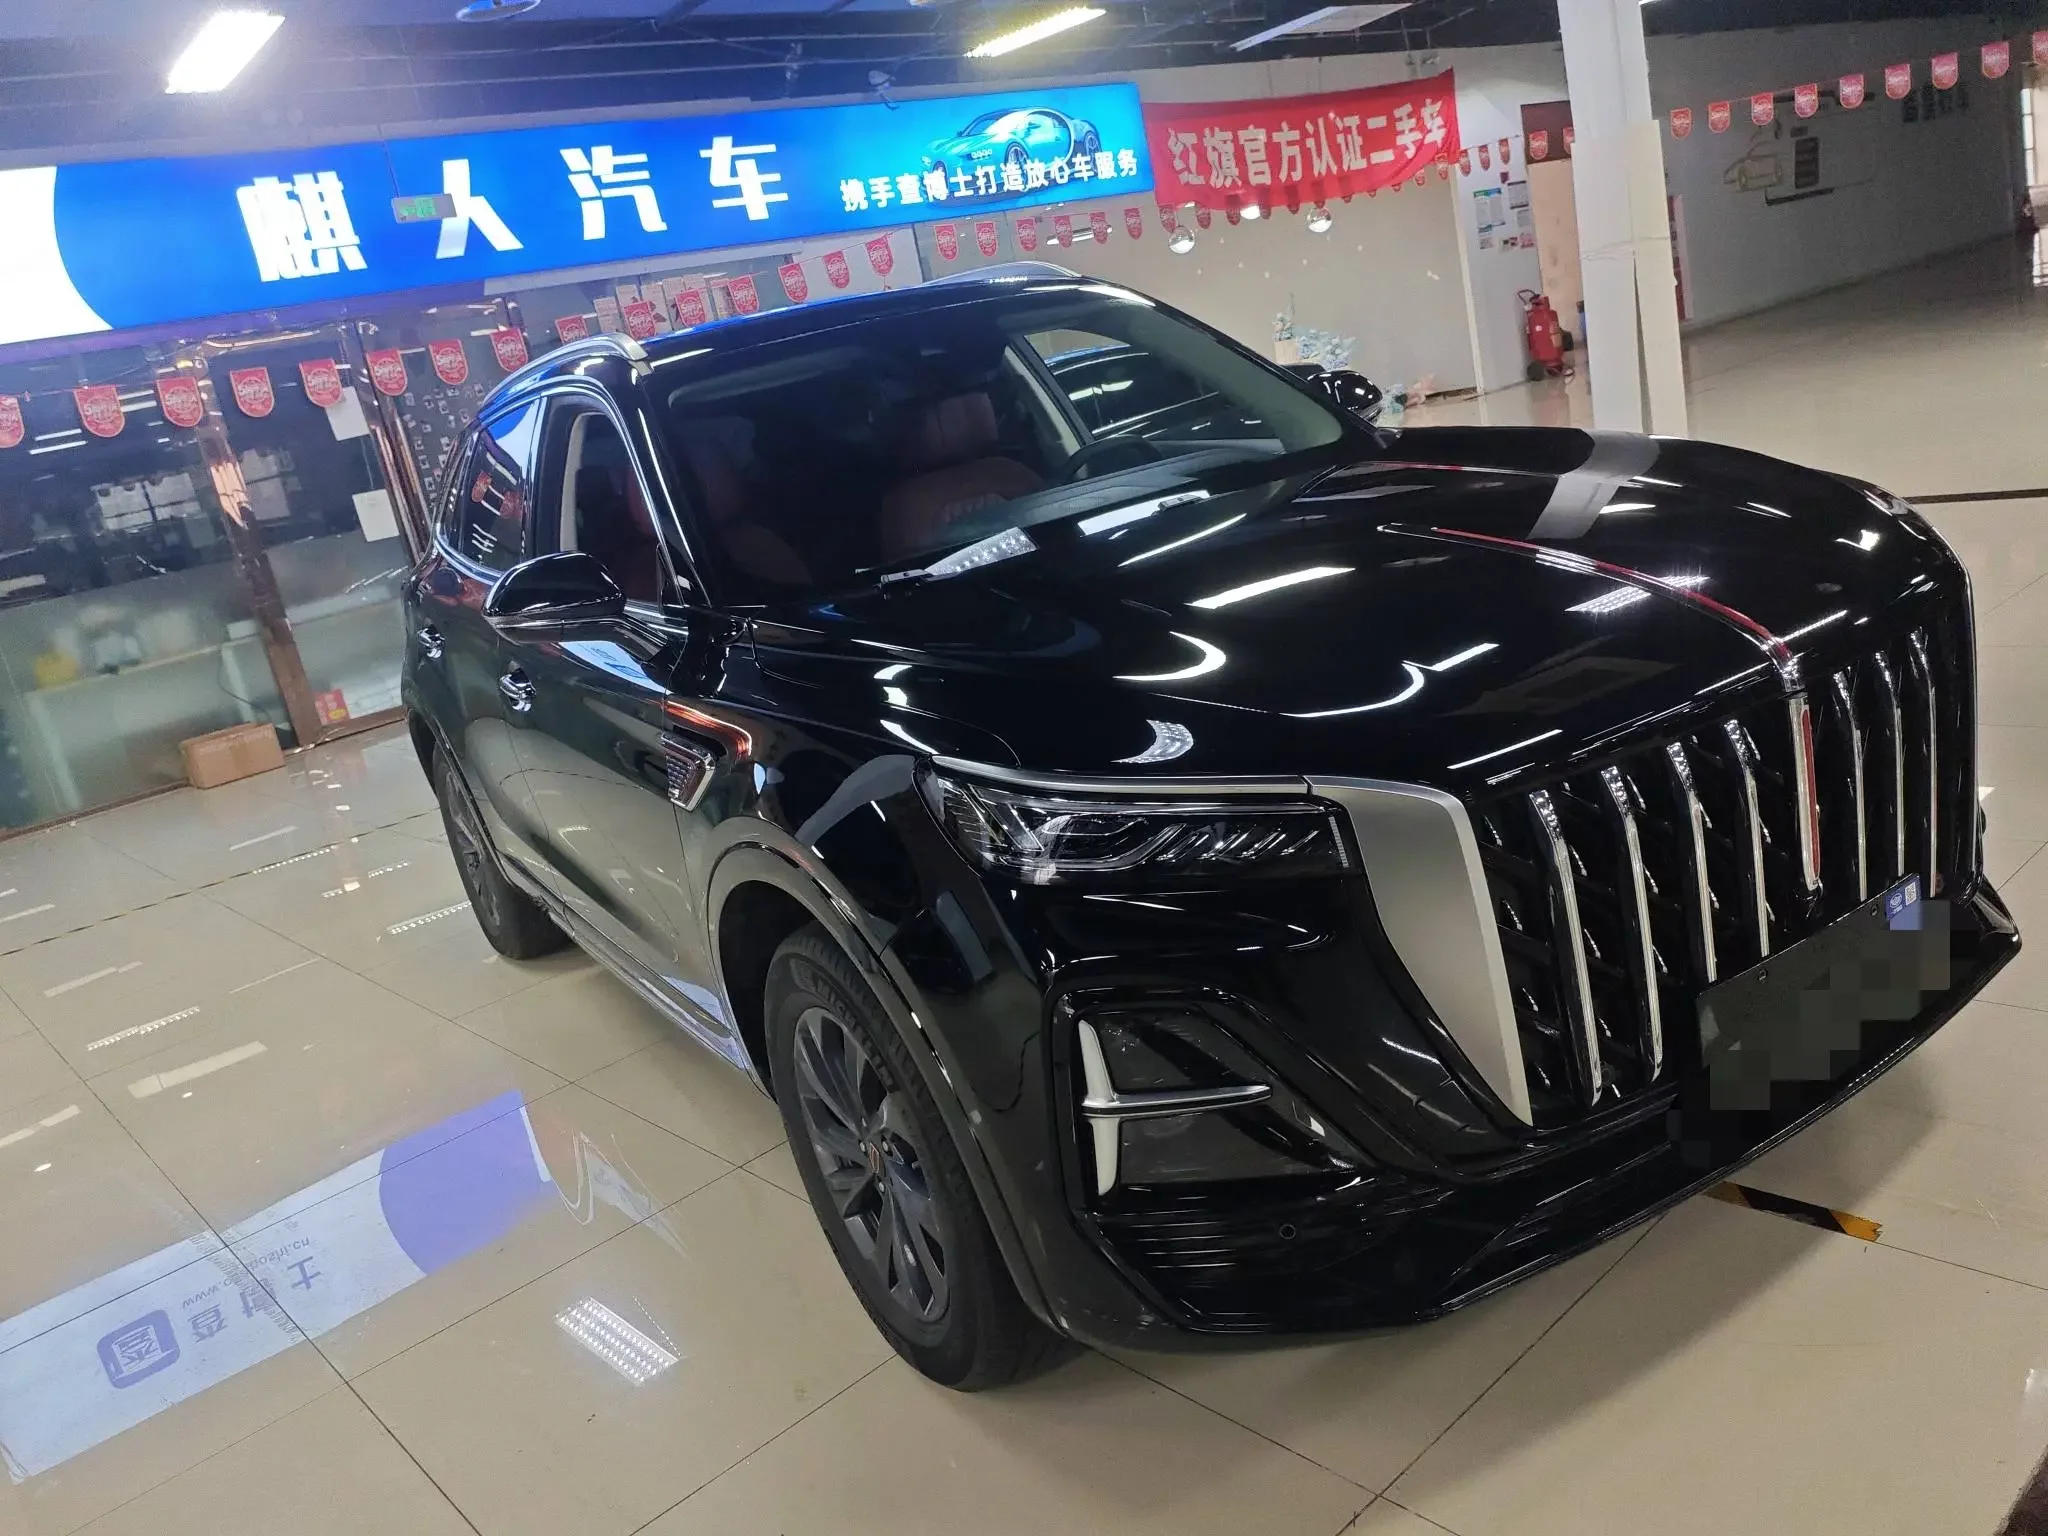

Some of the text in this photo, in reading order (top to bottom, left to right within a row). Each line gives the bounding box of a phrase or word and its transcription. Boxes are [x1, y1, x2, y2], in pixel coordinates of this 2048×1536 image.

[840, 148, 1139, 212] 携手查博士打造放心车服务
[1167, 98, 1448, 188] 红旗官方认证二手车
